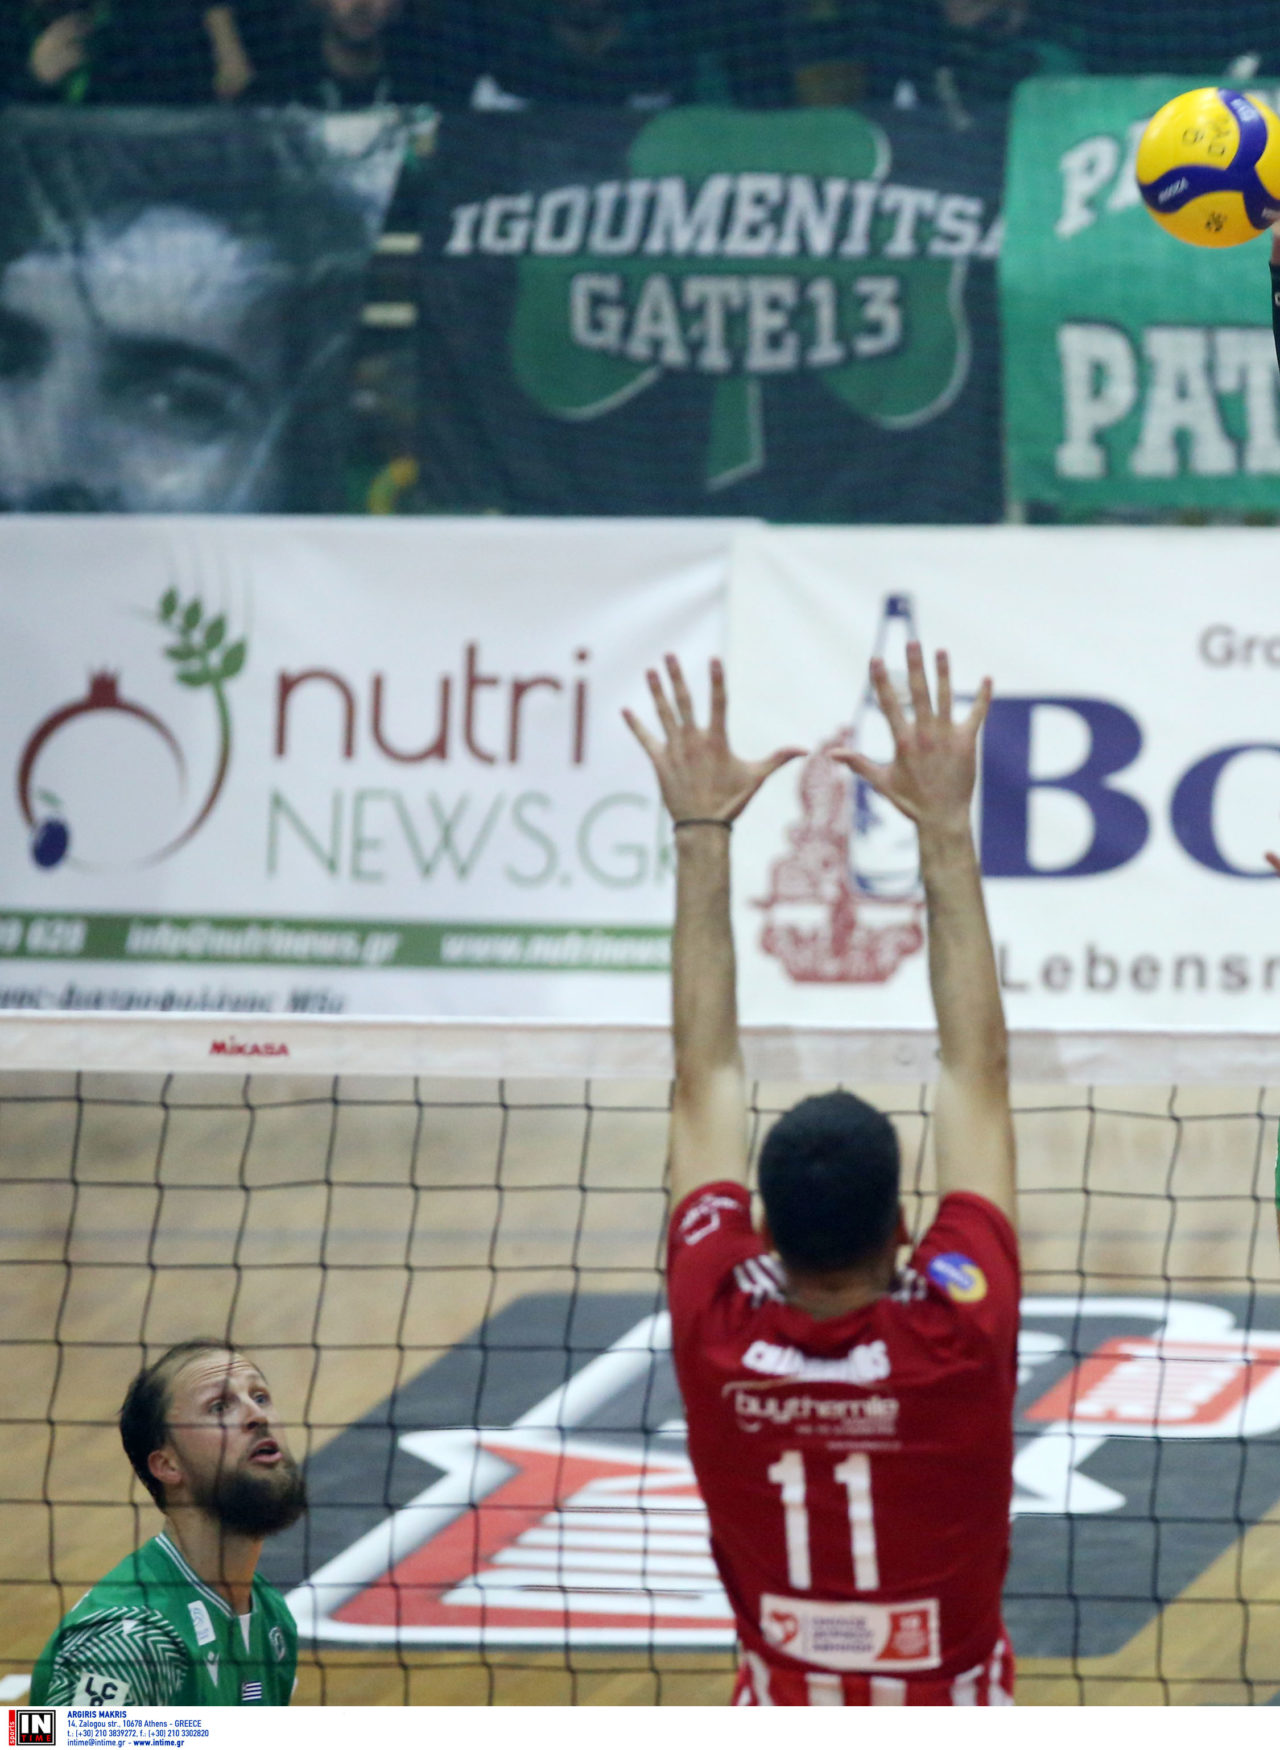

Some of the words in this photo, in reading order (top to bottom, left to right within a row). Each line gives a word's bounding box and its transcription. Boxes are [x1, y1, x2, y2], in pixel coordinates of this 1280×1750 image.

[569, 273, 903, 372] GATE13
[275, 641, 590, 767] nutri
[768, 1449, 880, 1592] 11
